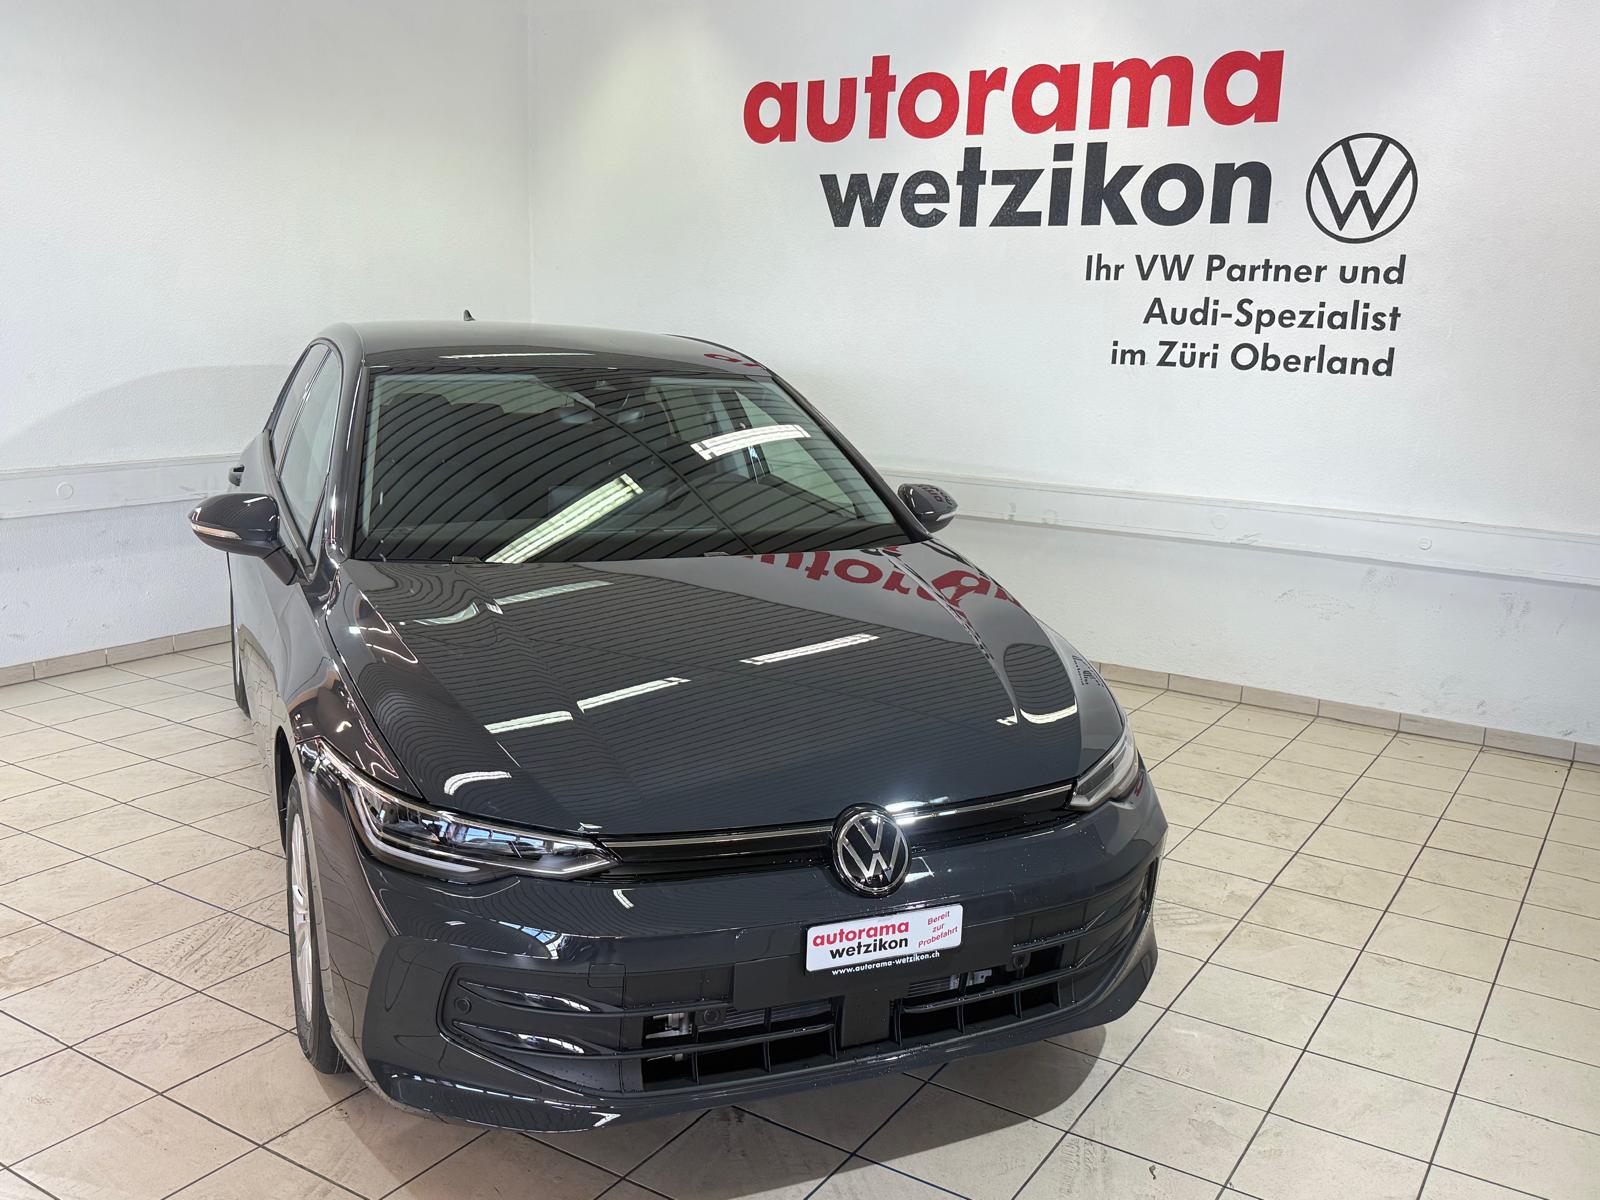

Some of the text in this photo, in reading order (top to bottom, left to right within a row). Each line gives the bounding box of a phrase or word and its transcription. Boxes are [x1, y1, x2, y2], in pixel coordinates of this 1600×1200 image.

[744, 51, 1285, 144] autorama
[820, 142, 1273, 228] wetzikon
[1086, 254, 1407, 285] Ihr VW Partner und
[1142, 296, 1402, 333] Audi-Spezialist
[1111, 340, 1396, 377] im Züri Oberland
[927, 910, 951, 926] Bereit
[932, 922, 945, 933] zur
[812, 921, 910, 947] autorama
[918, 926, 958, 948] Probefahrt
[829, 937, 909, 960] wetzikon
[831, 951, 940, 975] www.autorama-wetzikon.ch
